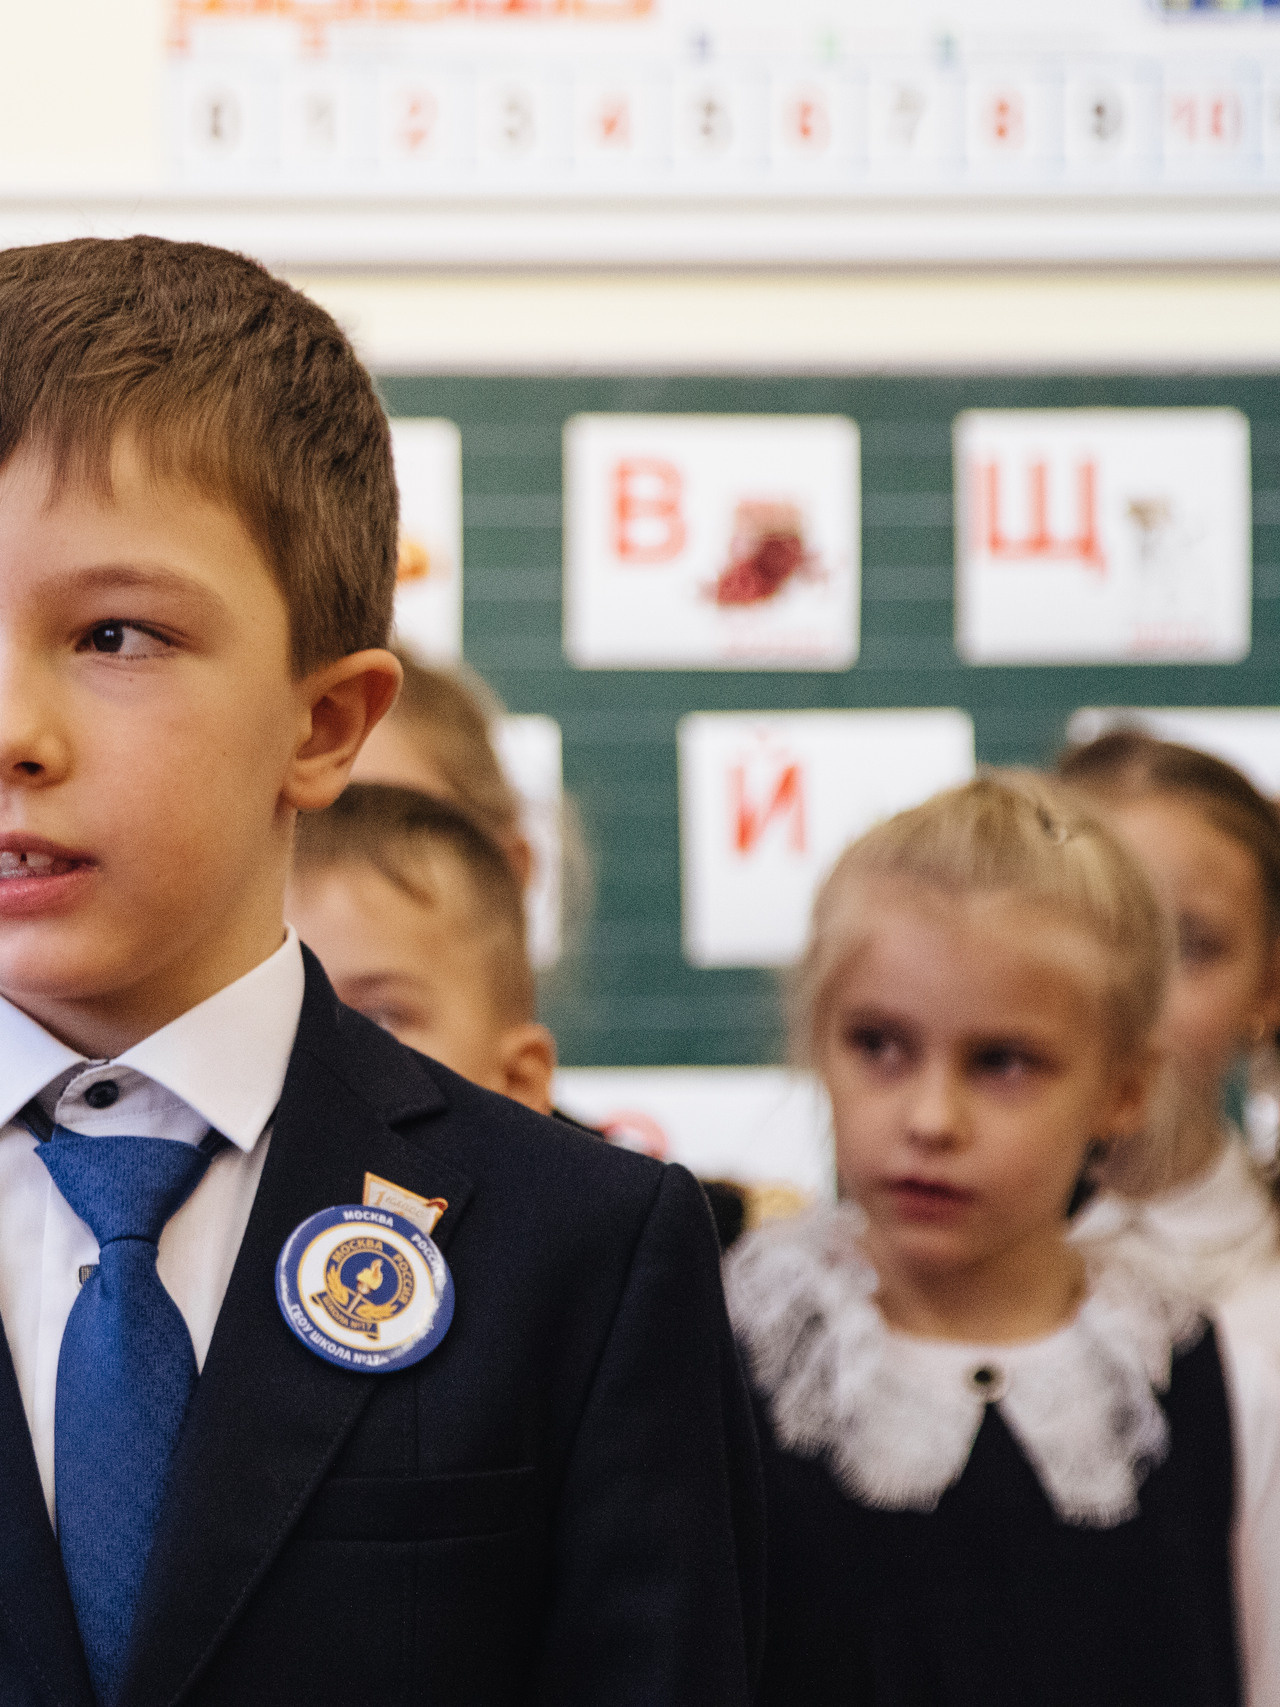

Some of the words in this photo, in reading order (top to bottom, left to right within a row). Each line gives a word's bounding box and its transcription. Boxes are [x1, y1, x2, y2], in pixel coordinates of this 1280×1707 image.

[194, 92, 239, 151] 0
[402, 92, 439, 151] 2
[490, 92, 536, 151] 3
[597, 92, 632, 151] 4
[685, 92, 732, 151] 5
[784, 92, 832, 151] 6
[984, 92, 1026, 151] 8
[1078, 92, 1123, 151] 9
[1168, 92, 1245, 151] 10
[610, 451, 688, 563] В
[974, 452, 1107, 574] Щ
[728, 731, 808, 856] Й
[343, 1210, 394, 1228] МОСКВА
[332, 1238, 384, 1263] МОСКВА
[393, 1253, 414, 1305] РОССИЯ
[309, 1330, 352, 1361] ШКОЛА
